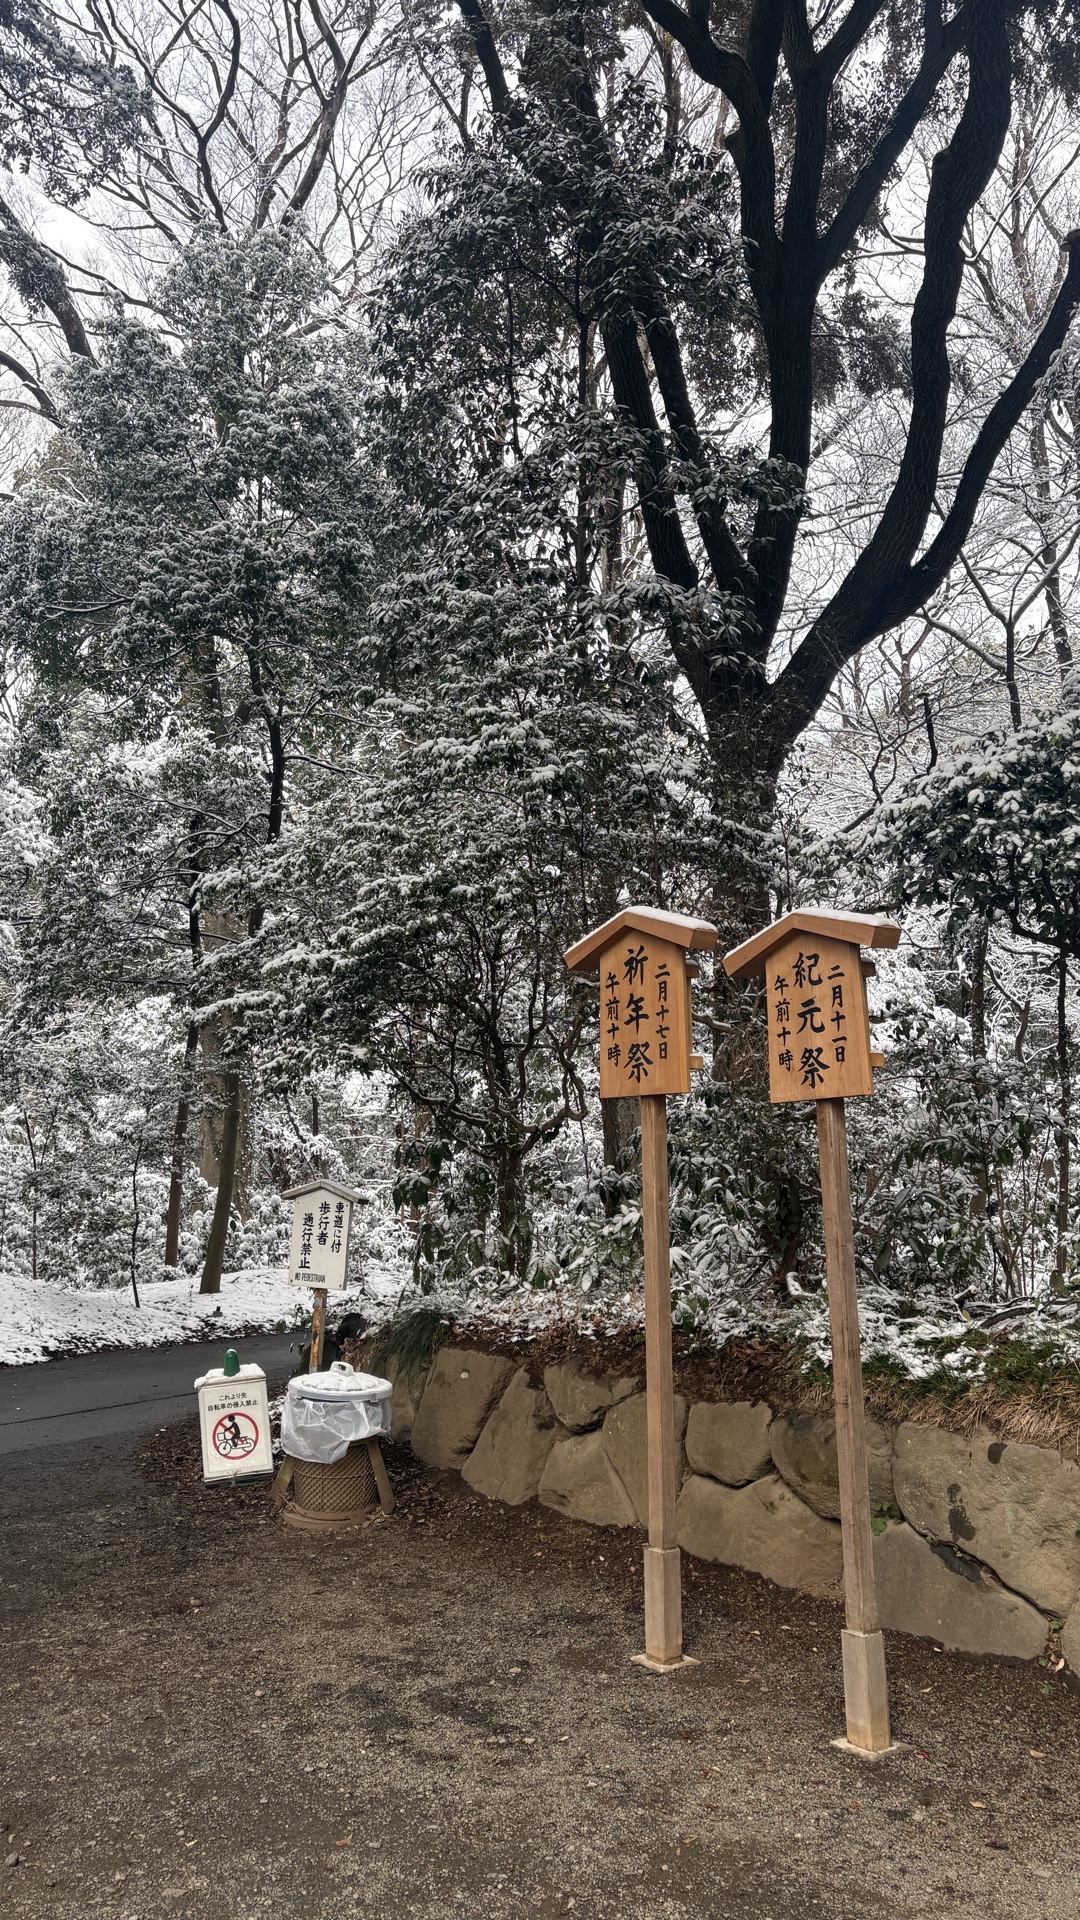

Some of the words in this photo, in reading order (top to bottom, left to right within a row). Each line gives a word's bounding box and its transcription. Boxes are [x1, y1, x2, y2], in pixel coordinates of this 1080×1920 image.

[605, 971, 622, 1067] 午前十時
[623, 945, 654, 1083] 祈年祭
[654, 963, 671, 1060] 二月十七日
[774, 975, 794, 1072] 午前十時
[792, 952, 830, 1089] 紀元祭
[827, 965, 847, 1063] 二月十一日
[298, 1212, 314, 1269] 通行禁止
[316, 1201, 331, 1245] 歩行者
[330, 1201, 344, 1253] 車道に付
[295, 1272, 301, 1281] NO
[219, 1392, 248, 1402] これより先
